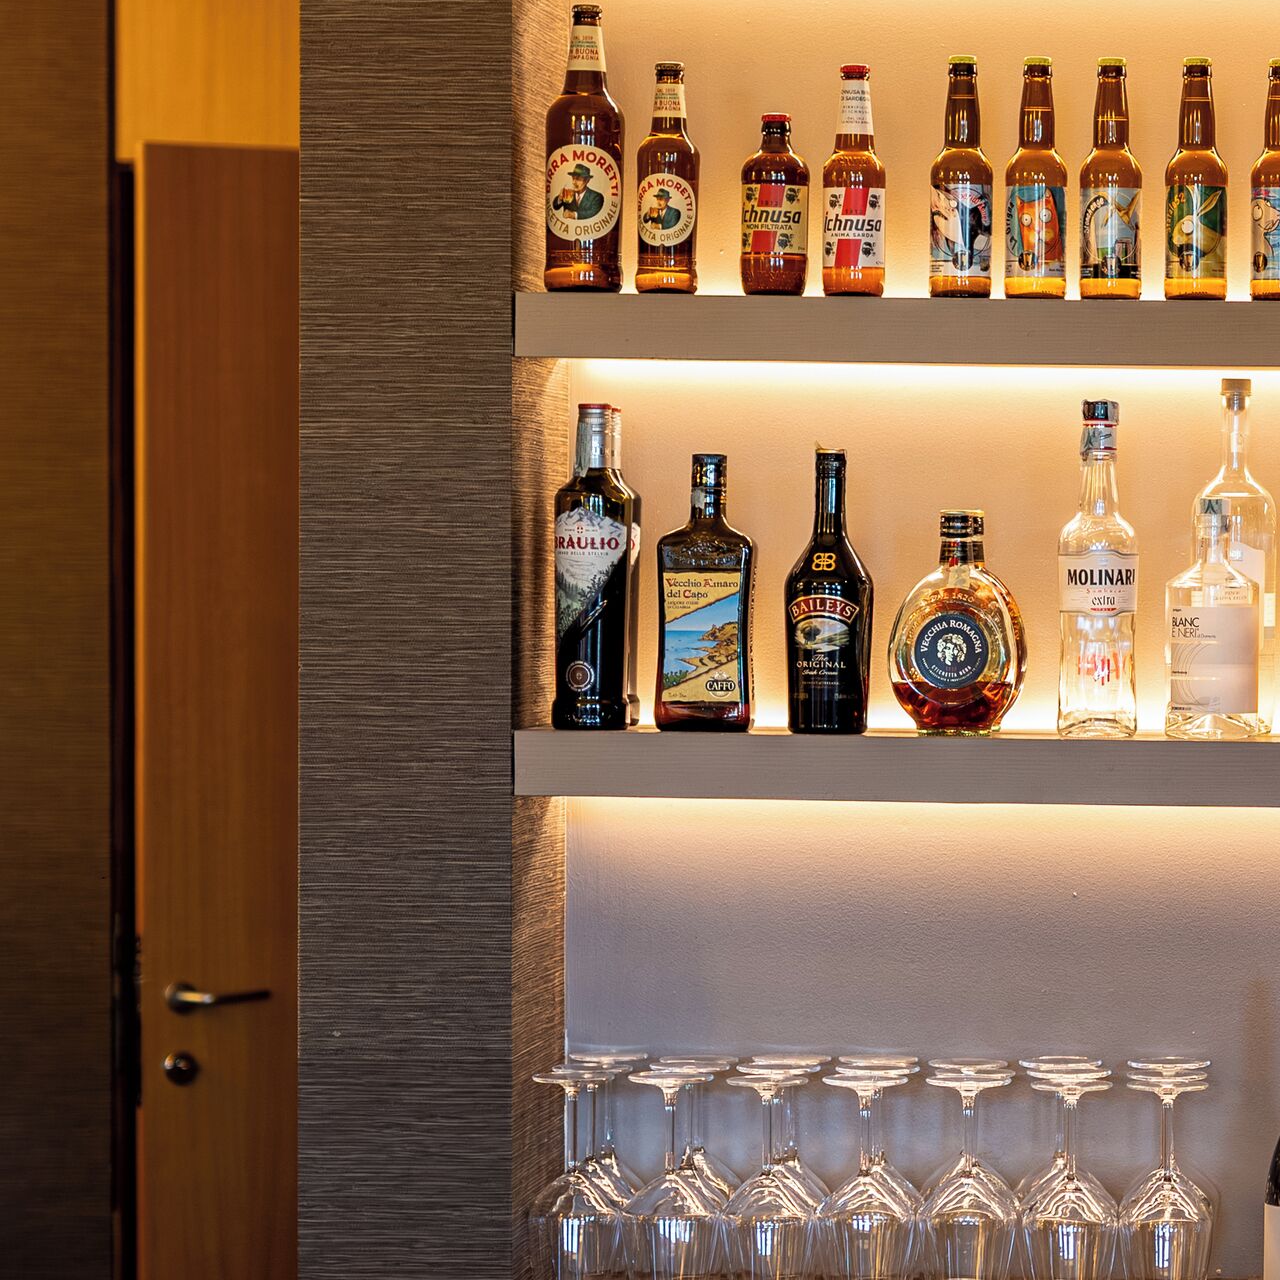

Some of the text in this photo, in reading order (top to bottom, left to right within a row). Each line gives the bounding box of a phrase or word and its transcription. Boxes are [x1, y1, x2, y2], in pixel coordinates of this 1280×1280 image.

[573, 150, 619, 197] MORETTI
[656, 178, 693, 211] MORETTI
[574, 201, 619, 237] ORIGINALE
[742, 202, 801, 224] ichnusa
[824, 211, 882, 233] ichnusa
[659, 215, 693, 242] ORIGINALE
[665, 578, 739, 588] Vecchio Amaro
[1067, 568, 1136, 586] MOLINARI
[666, 589, 709, 601] del Capo
[1091, 595, 1116, 606] extra
[792, 599, 855, 617] BAILEYS
[920, 619, 983, 654] VECCHIA ROMAGNA
[796, 661, 846, 669] ORIGINAL
[706, 681, 735, 691] CAFFO
